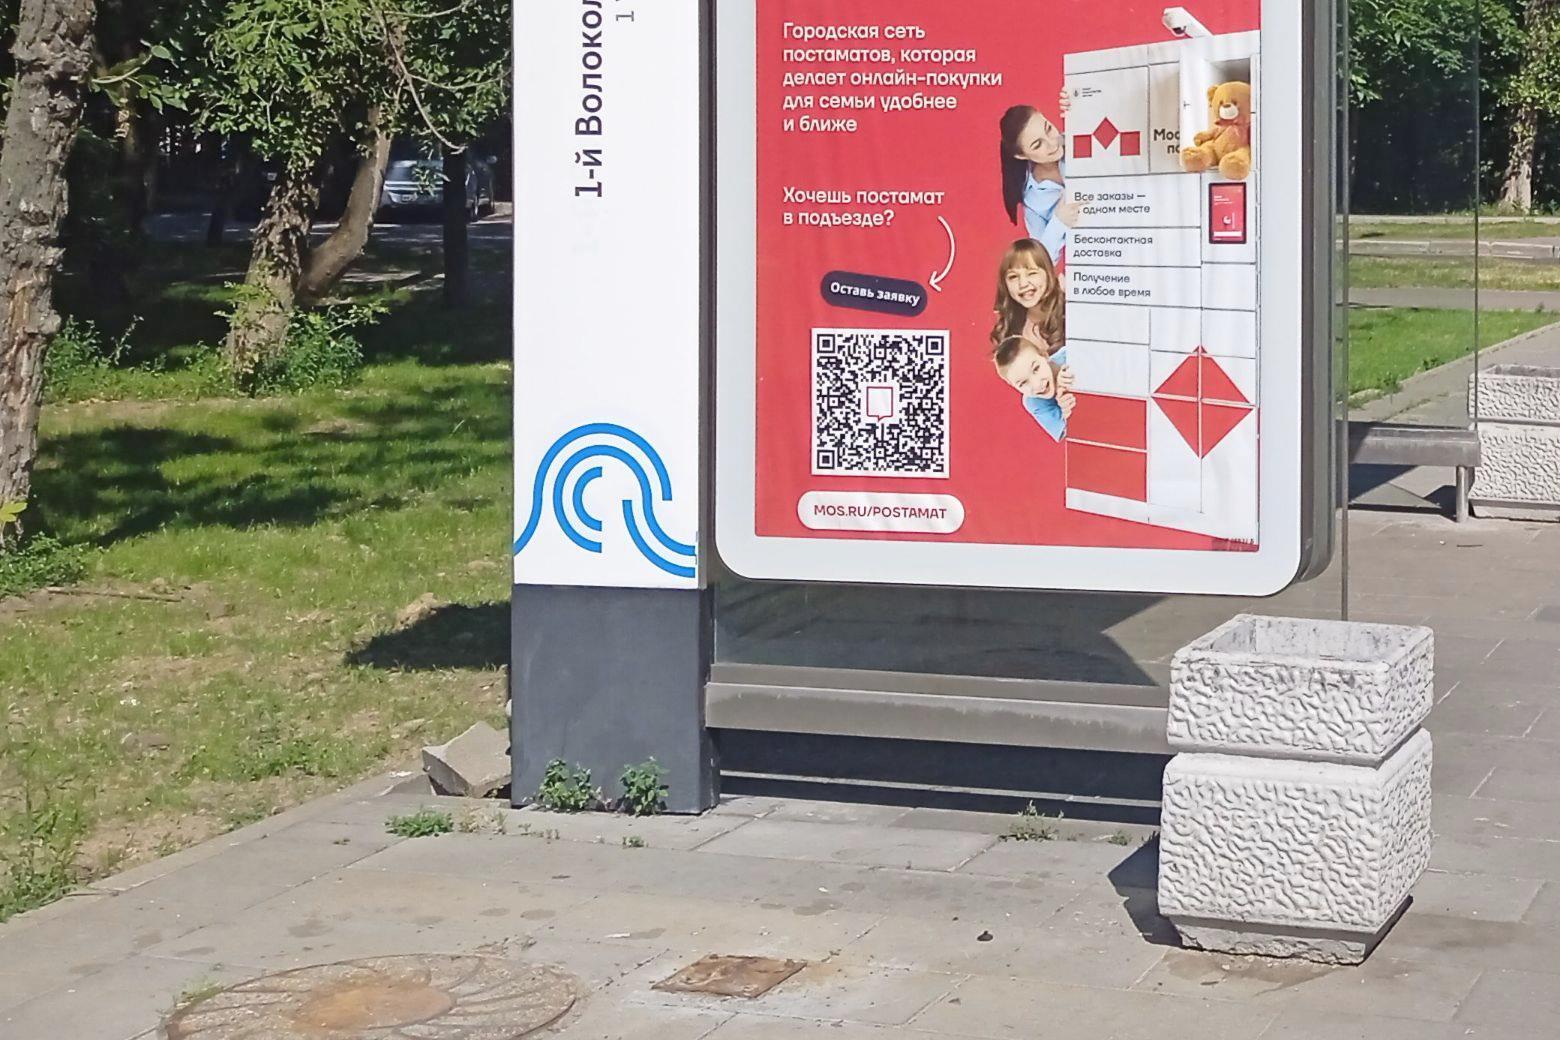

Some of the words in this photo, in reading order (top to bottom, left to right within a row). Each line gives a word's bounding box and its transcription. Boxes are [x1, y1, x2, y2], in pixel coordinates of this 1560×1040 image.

[616, 10, 634, 22] 1
[783, 22, 879, 42] Городская
[884, 25, 926, 39] сеть
[783, 48, 896, 65] постаматов,
[900, 48, 976, 66] которая
[783, 71, 846, 87] делает
[850, 69, 1003, 90] онлайн-покупки
[783, 95, 814, 111] для
[819, 95, 875, 109] семьи
[880, 92, 958, 113] удобнее
[783, 118, 795, 132] и
[799, 114, 858, 133] ближе
[574, 149, 602, 198] 1-й
[783, 186, 852, 204] Хочешь
[856, 190, 945, 205] постамат
[1074, 191, 1095, 202] Все
[1097, 192, 1134, 201] заказы
[783, 212, 794, 225] в
[798, 210, 895, 228] подъезде?
[1082, 205, 1116, 216] одном
[1118, 204, 1151, 214] месте
[1073, 234, 1154, 245] Бесконтактная
[1073, 249, 1122, 258] доставка
[1073, 272, 1131, 285] Получение
[830, 281, 875, 299] Оставь
[876, 290, 921, 307] заявку
[1073, 287, 1080, 295] в
[1081, 286, 1116, 296] любое
[1118, 290, 1152, 299] время
[813, 504, 948, 520] MOS.RU/POSTAMAT
